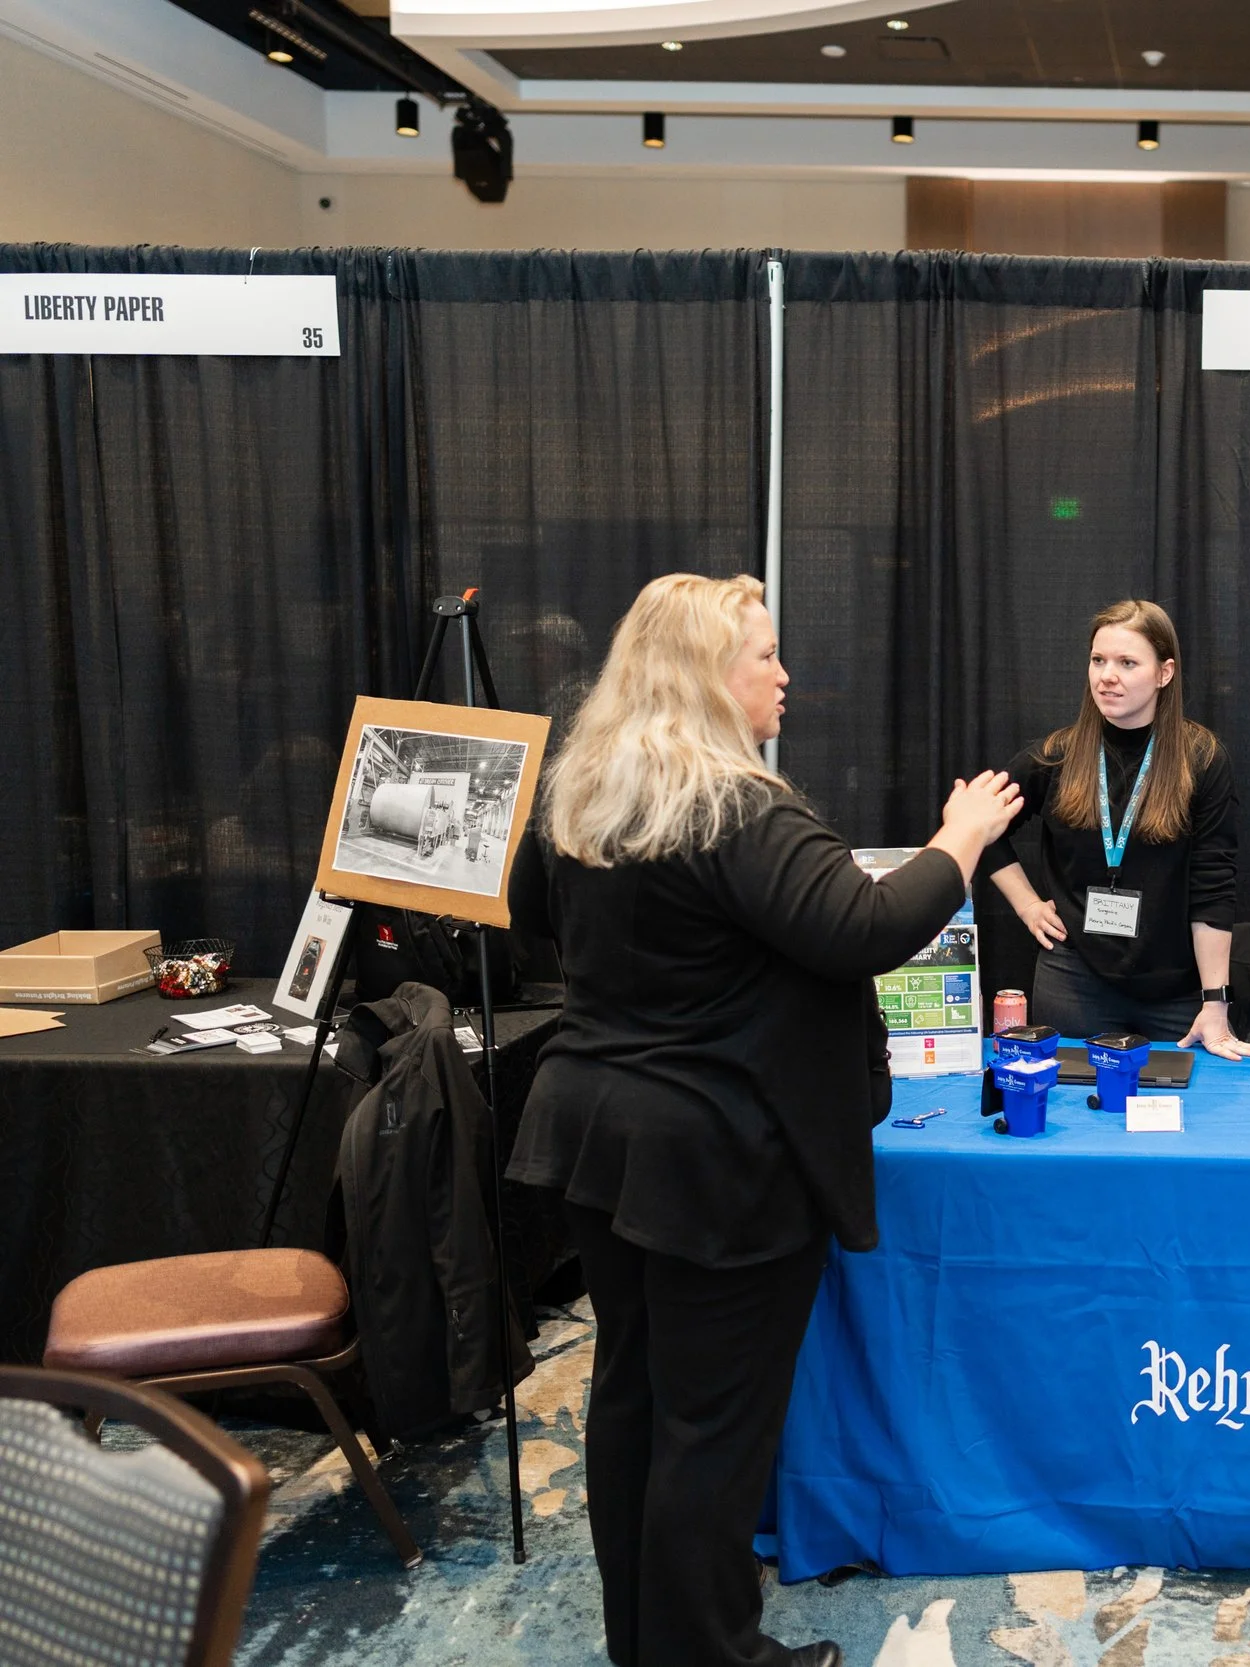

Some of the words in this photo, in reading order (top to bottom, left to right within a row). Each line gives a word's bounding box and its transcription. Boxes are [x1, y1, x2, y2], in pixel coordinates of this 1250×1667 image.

[24, 294, 97, 321] LIBERTY
[104, 296, 164, 322] PAPER
[302, 327, 323, 349] 35
